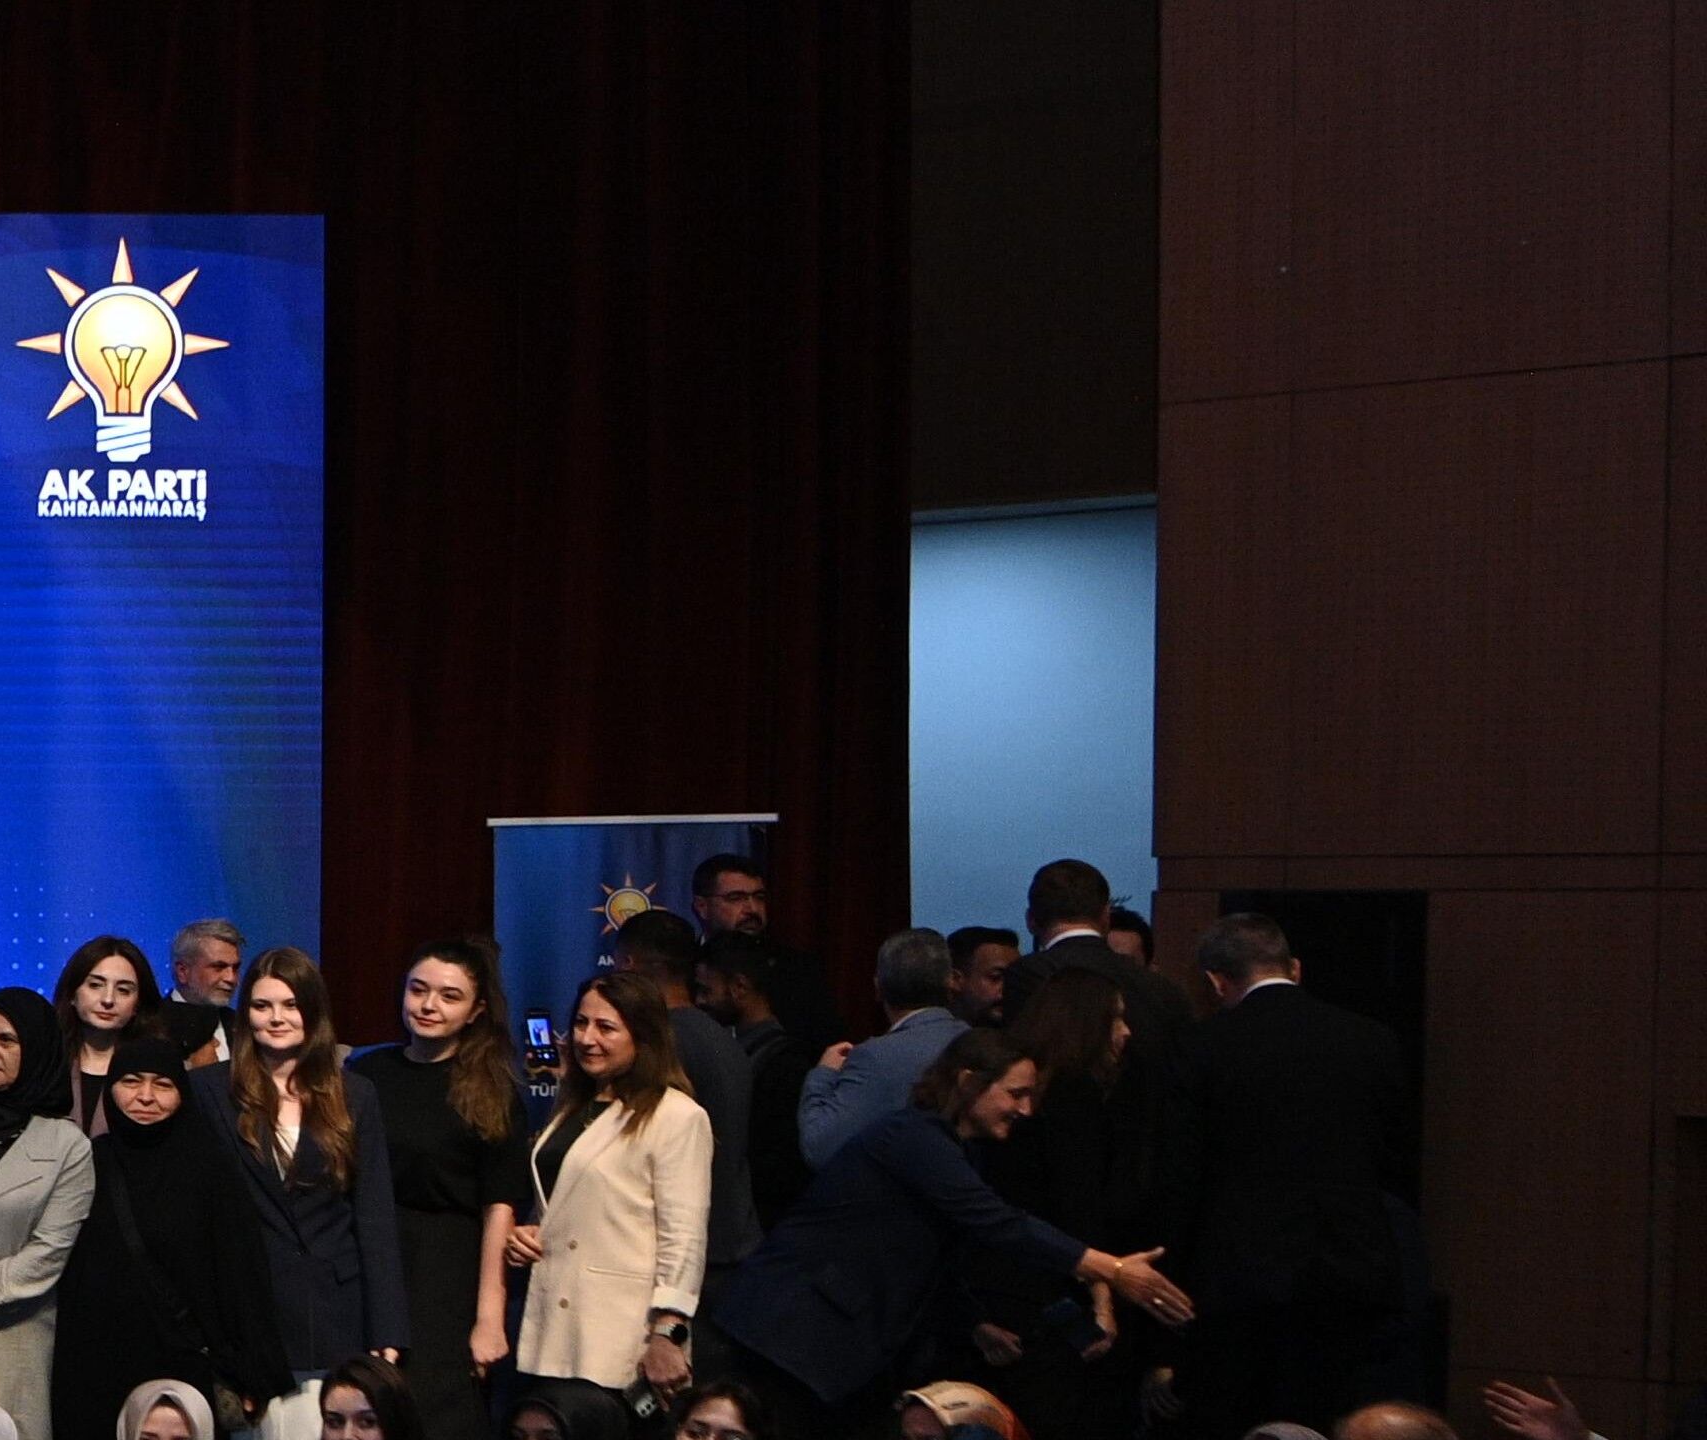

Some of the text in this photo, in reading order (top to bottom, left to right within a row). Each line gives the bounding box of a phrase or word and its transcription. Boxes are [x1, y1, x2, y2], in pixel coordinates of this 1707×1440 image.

[38, 469, 207, 500] AK PARTİ
[37, 500, 207, 521] KAHRAMANMARAŞ
